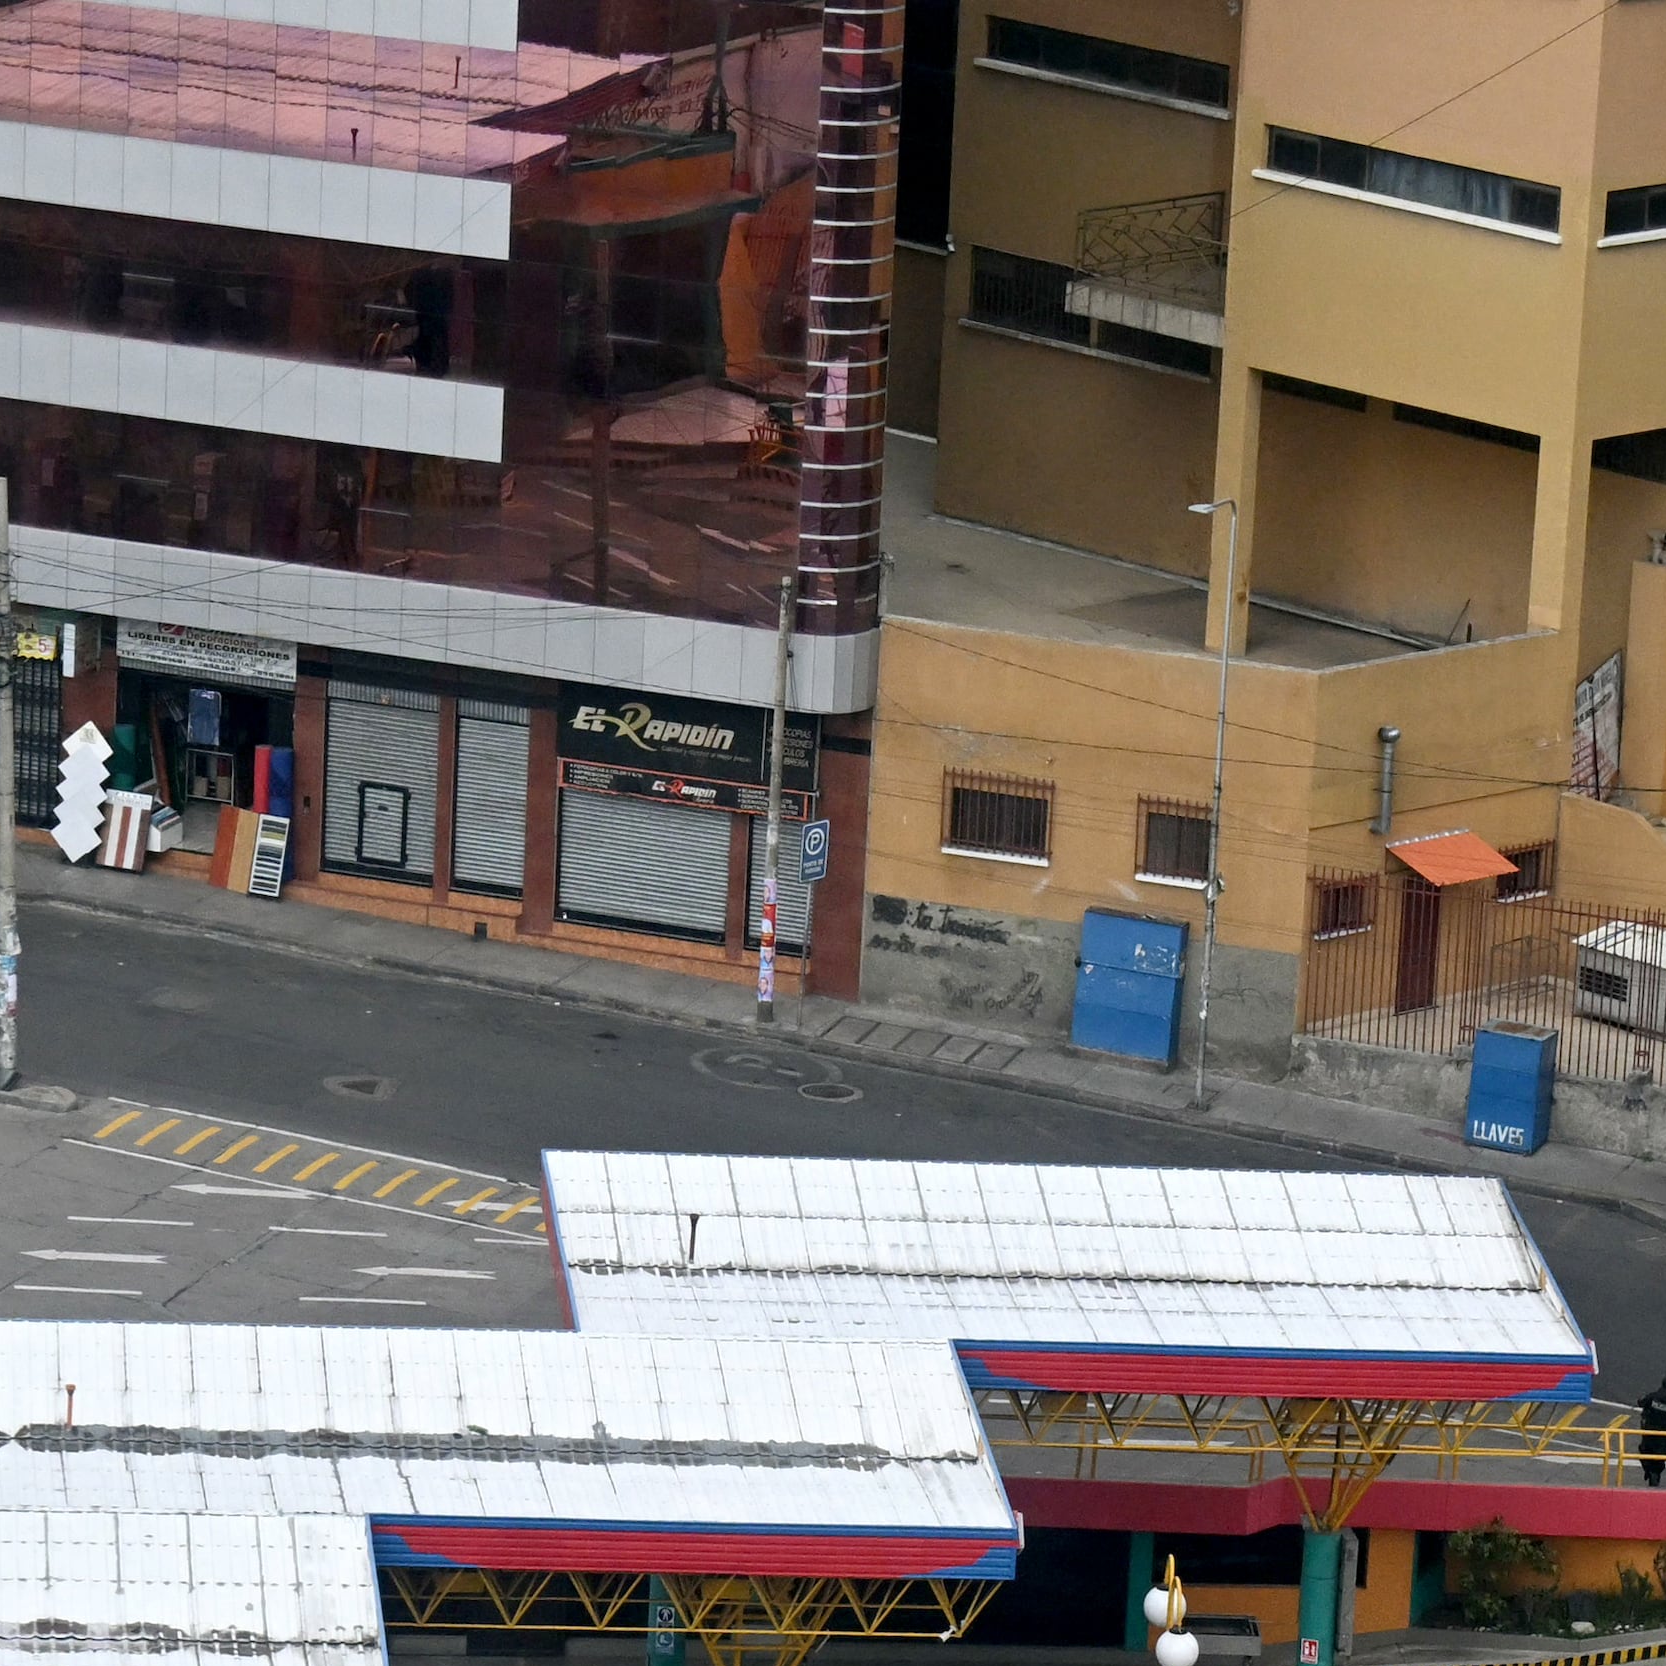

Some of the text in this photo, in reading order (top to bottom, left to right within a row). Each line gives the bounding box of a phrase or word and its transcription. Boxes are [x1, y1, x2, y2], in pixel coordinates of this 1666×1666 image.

[128, 632, 176, 644] LIDERES
[180, 639, 195, 647] EN
[199, 642, 290, 660] DECORACIONES
[186, 631, 259, 648] Decoraciones
[810, 835, 822, 850] P
